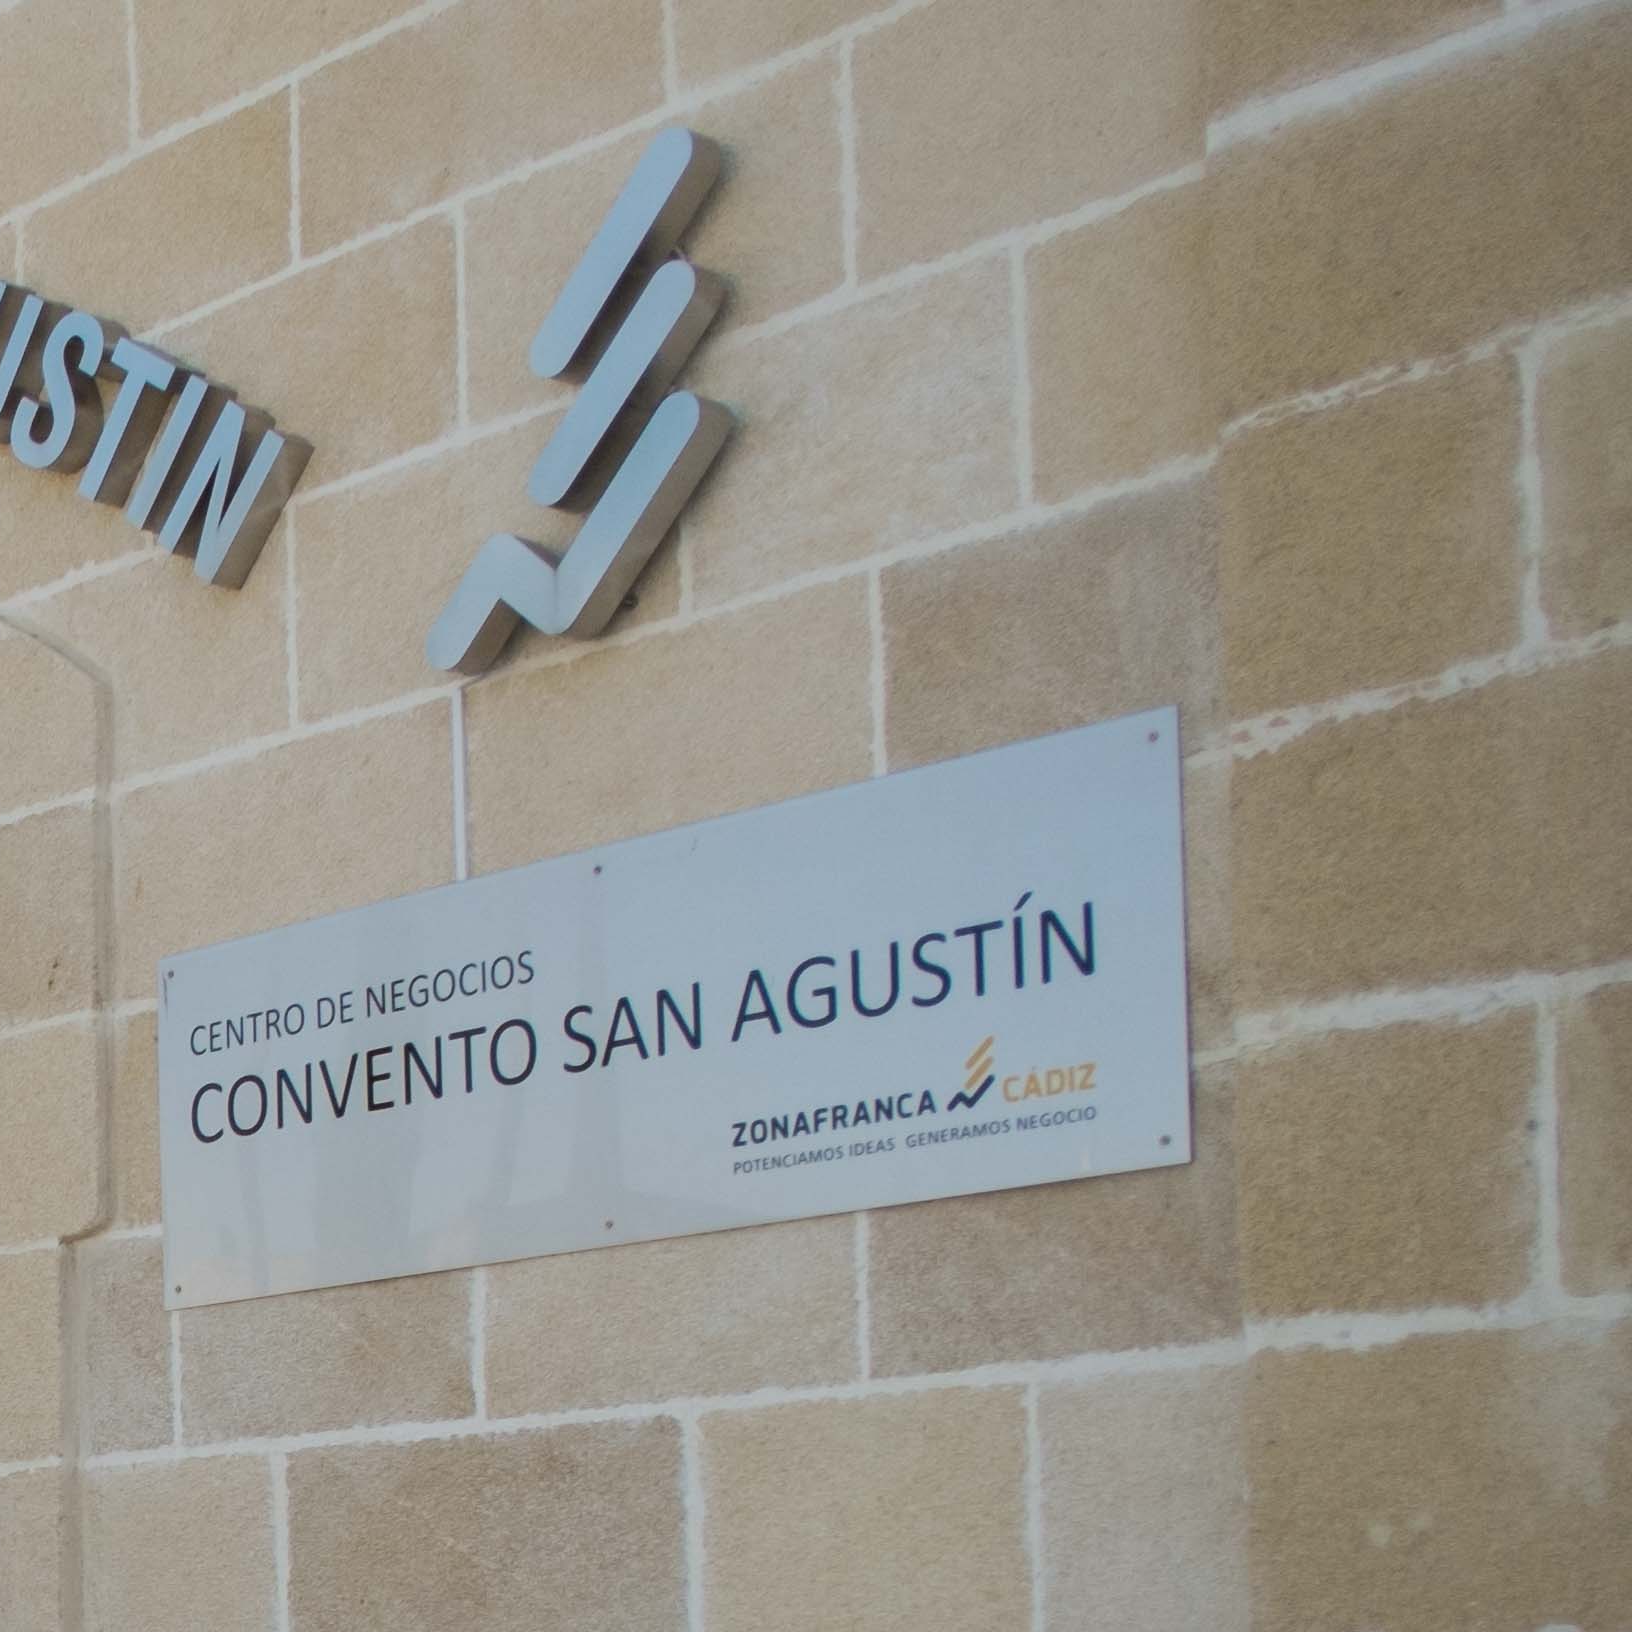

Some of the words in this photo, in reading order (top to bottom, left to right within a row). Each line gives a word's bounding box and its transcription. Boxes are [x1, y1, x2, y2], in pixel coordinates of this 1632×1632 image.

[189, 1003, 305, 1056] CENTRO
[316, 991, 354, 1029] DE
[366, 950, 535, 1018] NEGOCIOS
[191, 1018, 537, 1144] CONVENTO
[562, 981, 703, 1073] SAN
[731, 891, 1096, 1042] AGUSTÍN
[731, 1089, 937, 1148] ZONAFRANCA
[1001, 1062, 1097, 1104] CÁDIZ
[732, 1146, 844, 1175] POTENCIAMOS
[848, 1137, 896, 1158] IDEAS
[905, 1118, 1011, 1149] GENERAMOS
[1016, 1105, 1097, 1131] NEGOCIO
